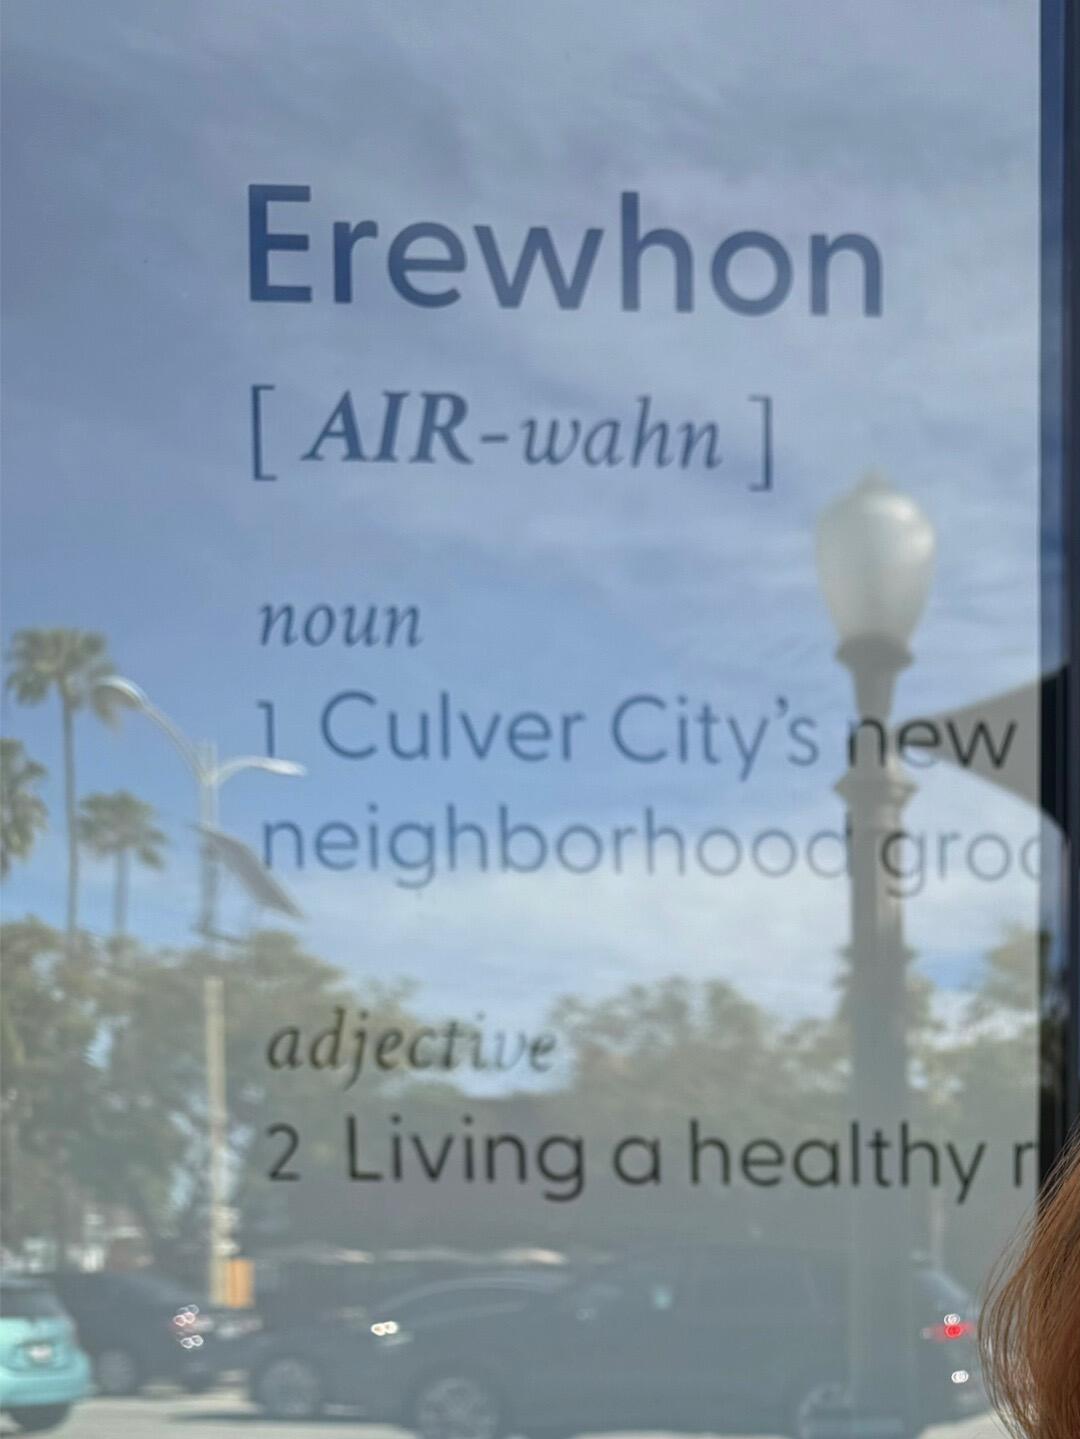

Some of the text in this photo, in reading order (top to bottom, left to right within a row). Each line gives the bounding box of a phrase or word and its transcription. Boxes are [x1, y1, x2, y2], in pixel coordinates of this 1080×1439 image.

[248, 184, 884, 318] Erewhon
[301, 390, 722, 470] AIR-wahn
[258, 603, 422, 648] noun
[256, 701, 275, 757] 1
[320, 690, 586, 763] Culver
[611, 694, 818, 782] City’s
[847, 716, 1017, 768] new
[263, 804, 850, 888] neighborhood
[267, 1009, 555, 1089] adjective
[268, 1124, 300, 1181] 2
[346, 1115, 586, 1201] Living
[613, 1134, 661, 1184] a
[690, 1119, 985, 1204] healthy
